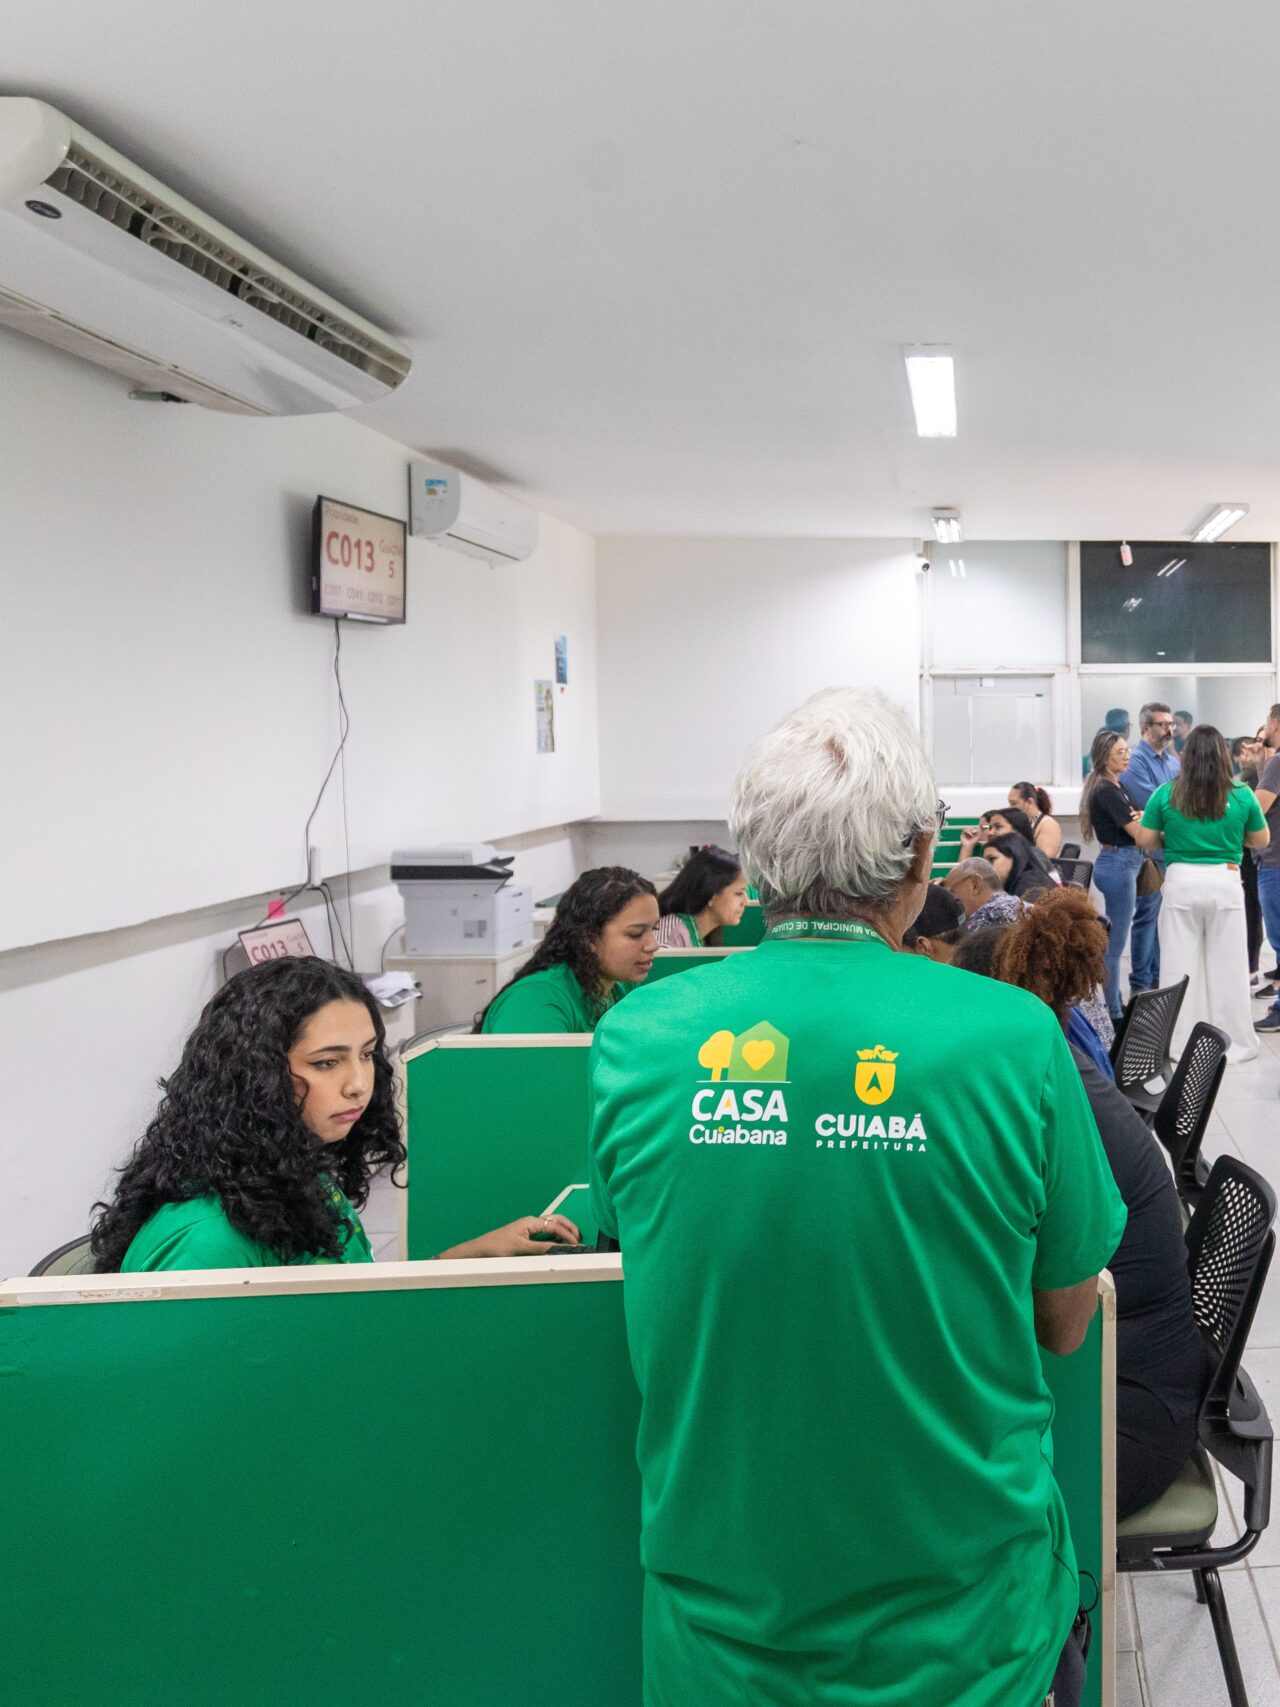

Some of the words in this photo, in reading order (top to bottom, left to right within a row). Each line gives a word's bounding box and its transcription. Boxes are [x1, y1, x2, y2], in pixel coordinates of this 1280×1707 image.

[325, 531, 375, 573] C013
[388, 561, 395, 578] 5
[795, 921, 808, 930] DE
[811, 921, 864, 934] MUNICIPAL
[250, 940, 288, 963] C013
[691, 1088, 789, 1122] CASA
[689, 1124, 787, 1145] Cuiabana
[815, 1113, 927, 1140] CUIABÁ
[816, 1140, 927, 1152] PREFEITURA
